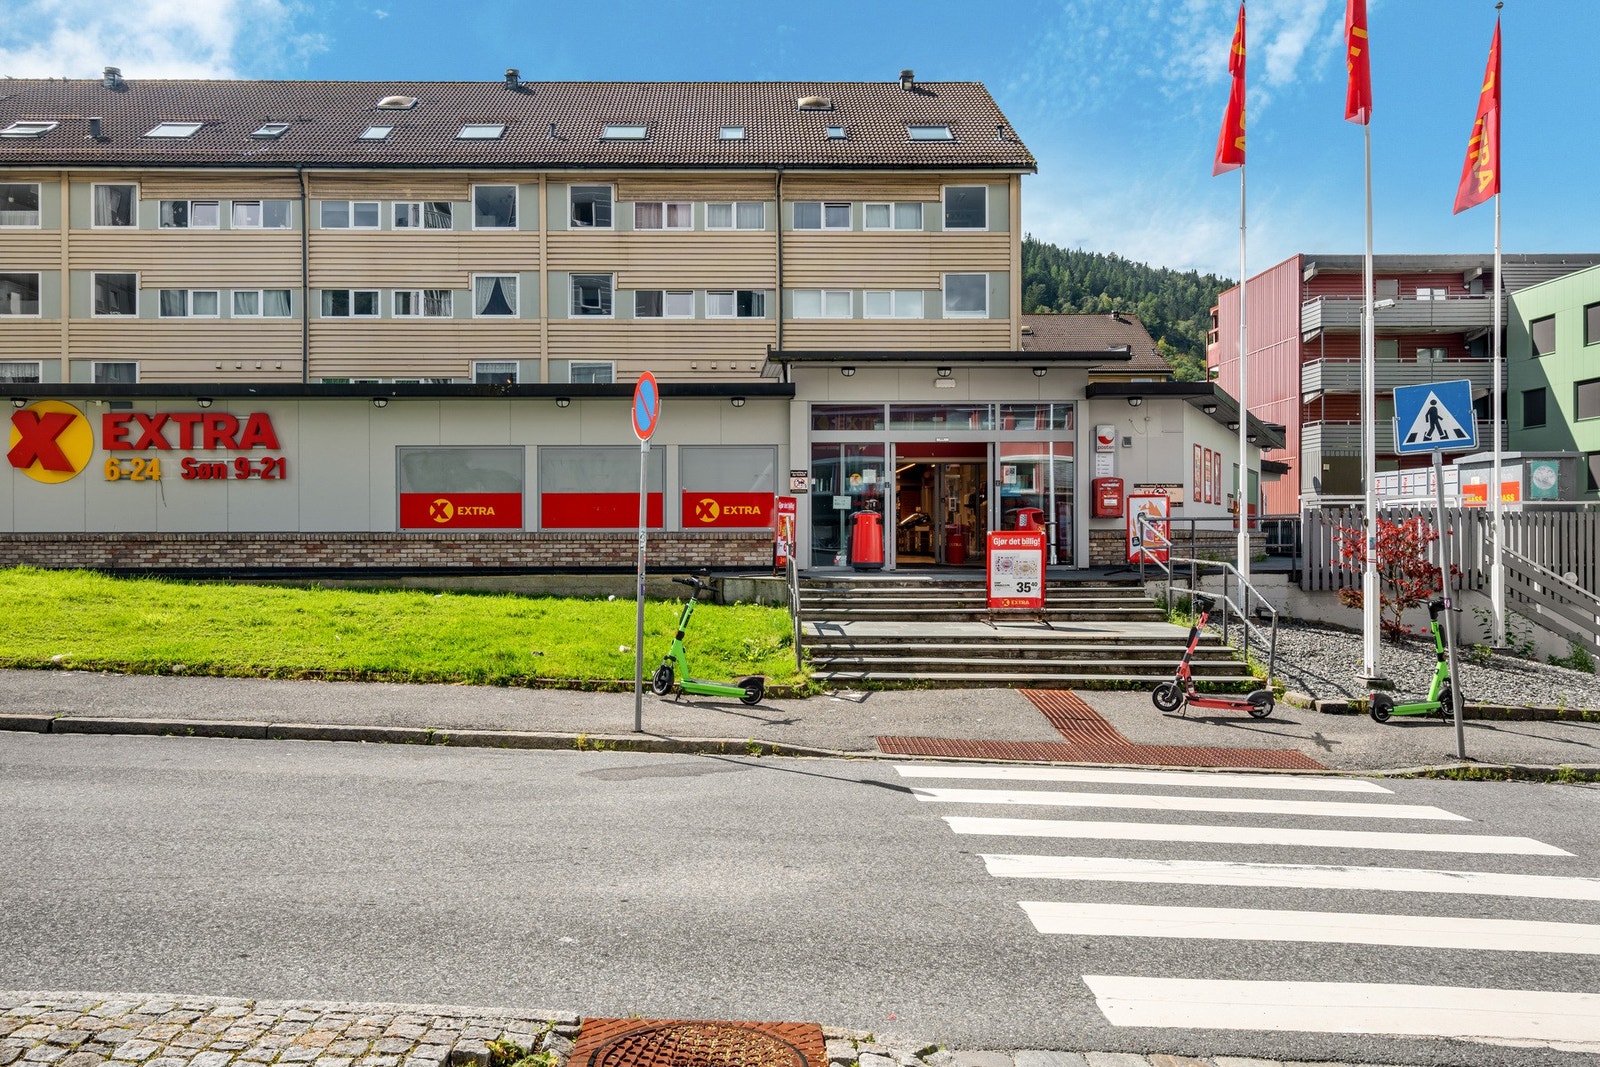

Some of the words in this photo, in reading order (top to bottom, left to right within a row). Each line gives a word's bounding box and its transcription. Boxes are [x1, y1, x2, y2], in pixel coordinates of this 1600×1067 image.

[102, 412, 282, 451] EXTRA
[104, 457, 162, 481] 6-24
[181, 457, 228, 481] Søn
[234, 457, 287, 481] 9-21
[457, 506, 496, 516] EXTRA
[723, 505, 761, 515] EXTRA
[993, 537, 1007, 546] Gjør
[1009, 537, 1020, 545] det
[1021, 537, 1041, 546] billig!
[1016, 581, 1031, 593] 35
